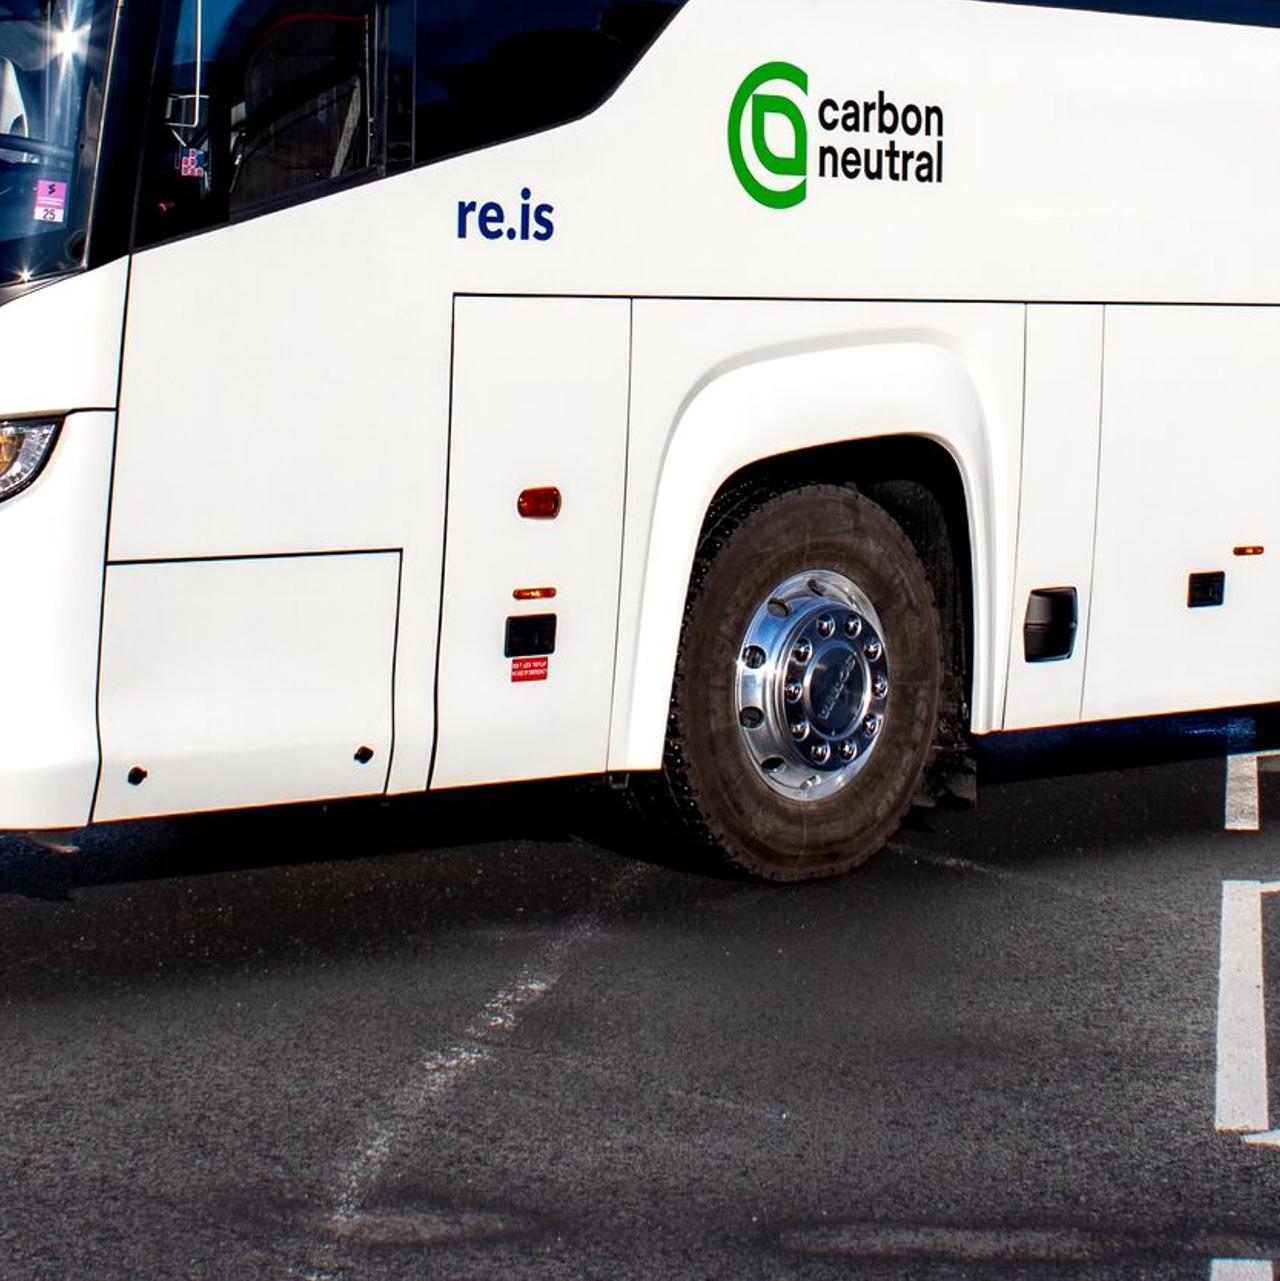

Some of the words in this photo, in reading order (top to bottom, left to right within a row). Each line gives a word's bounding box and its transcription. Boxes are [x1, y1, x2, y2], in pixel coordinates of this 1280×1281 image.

[817, 90, 944, 137] carbon
[817, 140, 944, 183] neutral
[456, 186, 555, 241] re.is
